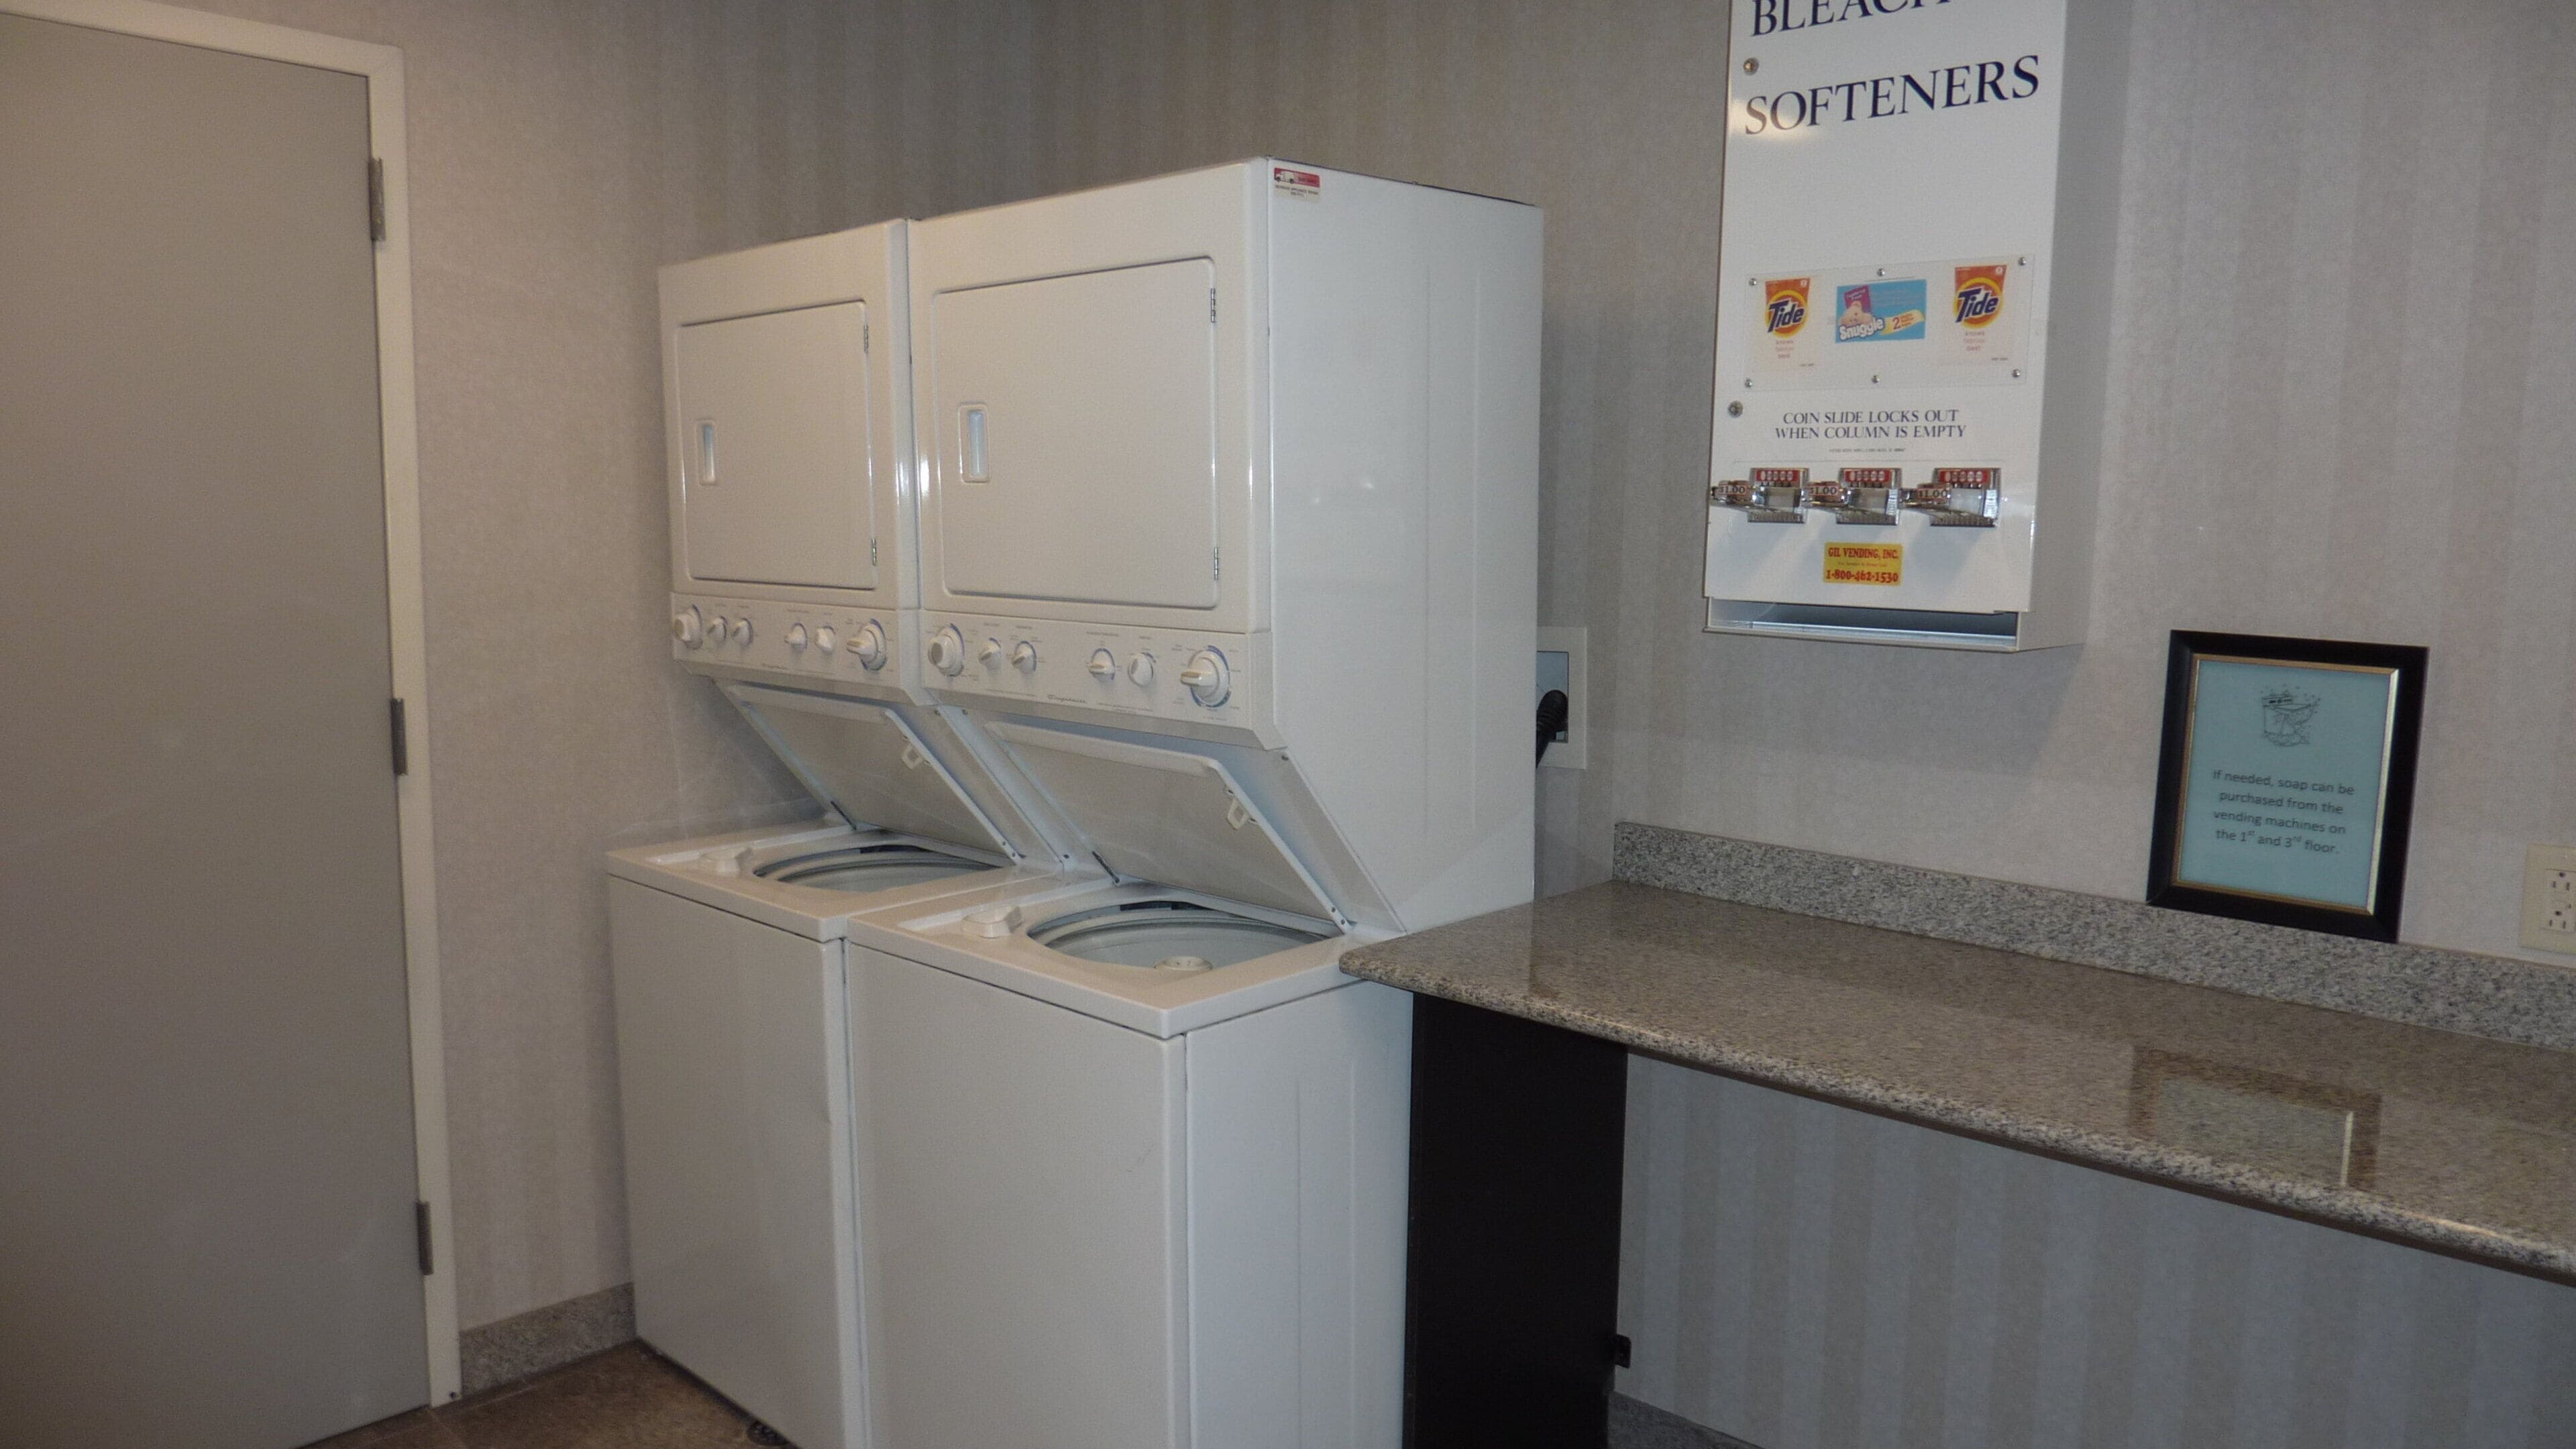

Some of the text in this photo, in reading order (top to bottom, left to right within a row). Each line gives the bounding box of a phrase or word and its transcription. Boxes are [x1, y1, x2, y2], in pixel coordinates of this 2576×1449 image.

[1745, 54, 2039, 136] SOFTENERS
[1767, 299, 1805, 333] Tide
[1955, 287, 1999, 323] Tide
[1839, 318, 1884, 341] Snuggle
[1782, 409, 1960, 425] COIN SLIDE LOCKS OUT
[1775, 425, 1967, 440] WHEN COLUMN IS EMPTY
[2212, 769, 2355, 796] If needed, soap can be
[2219, 791, 2344, 815] purchased from the
[2213, 810, 2347, 835] vending machines on
[2216, 828, 2237, 841] the
[2257, 835, 2281, 847] and
[2304, 839, 2340, 855] floor.
